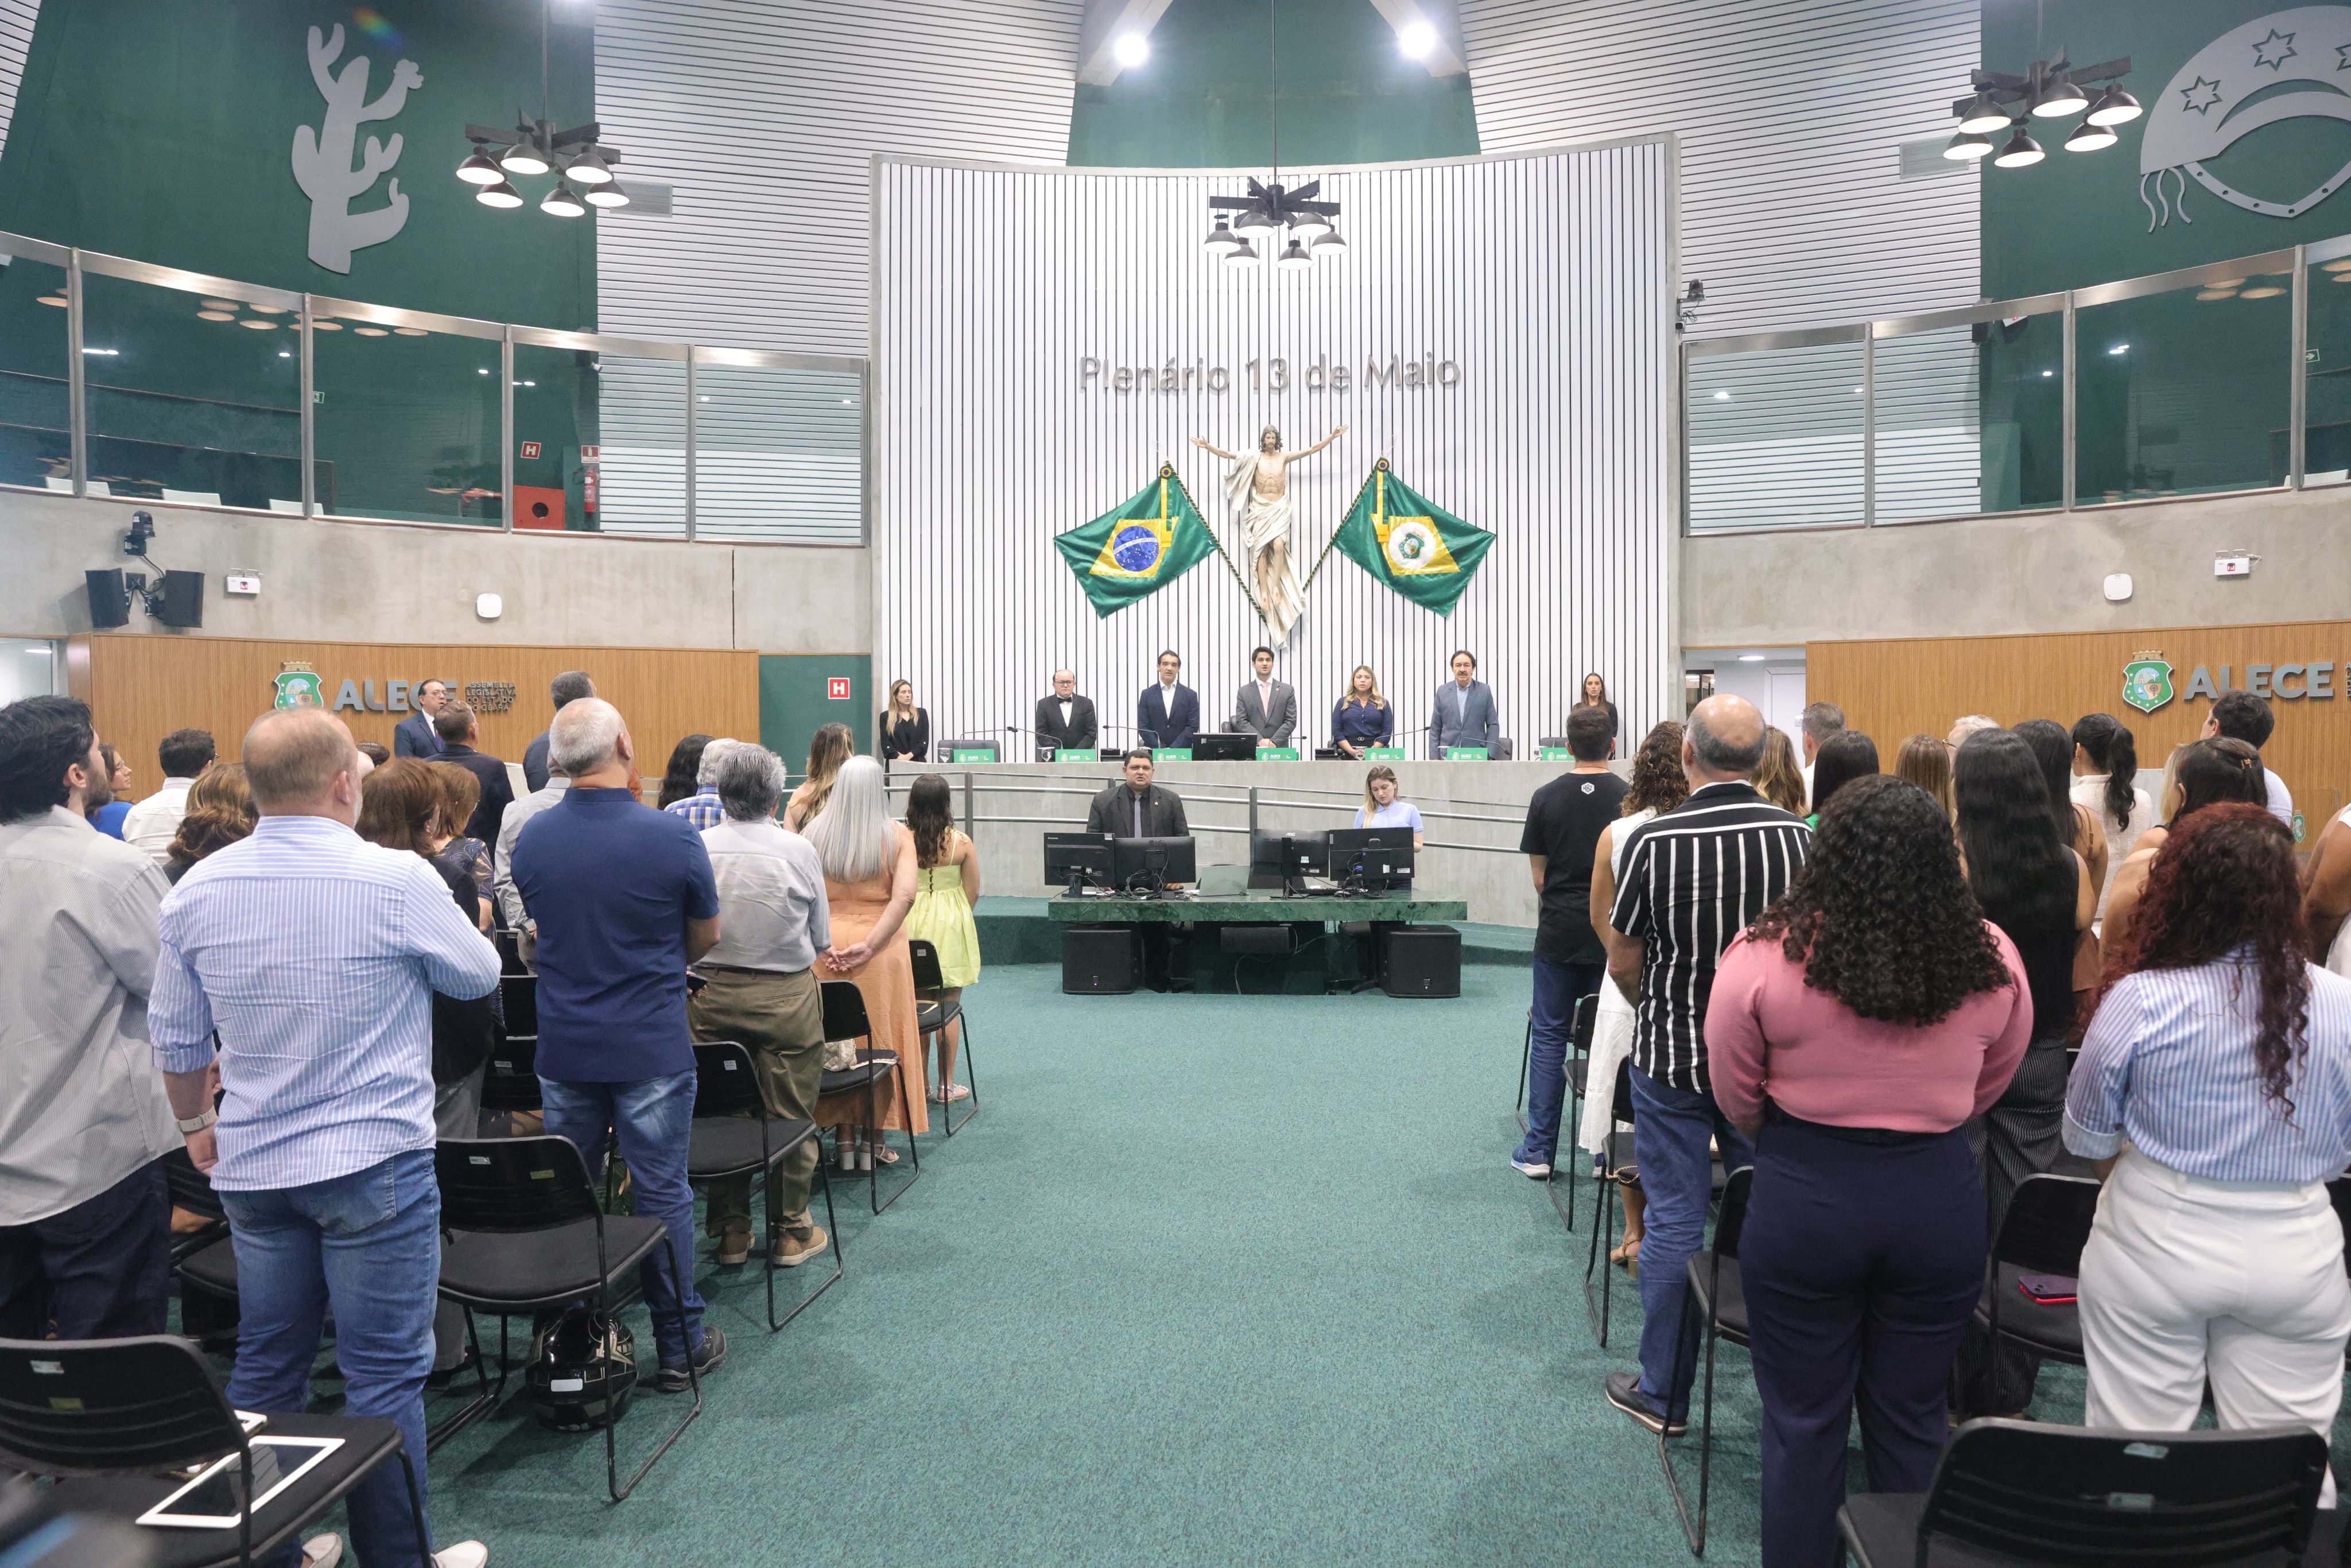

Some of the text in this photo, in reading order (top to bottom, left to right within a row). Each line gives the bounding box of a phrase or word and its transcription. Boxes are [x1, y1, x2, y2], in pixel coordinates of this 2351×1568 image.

[1081, 351, 1461, 390] Plenário 13 de Maio
[526, 445, 536, 456] H
[2183, 662, 2333, 699] ALECE
[833, 682, 845, 695] H
[482, 703, 509, 711] CEARÁ
